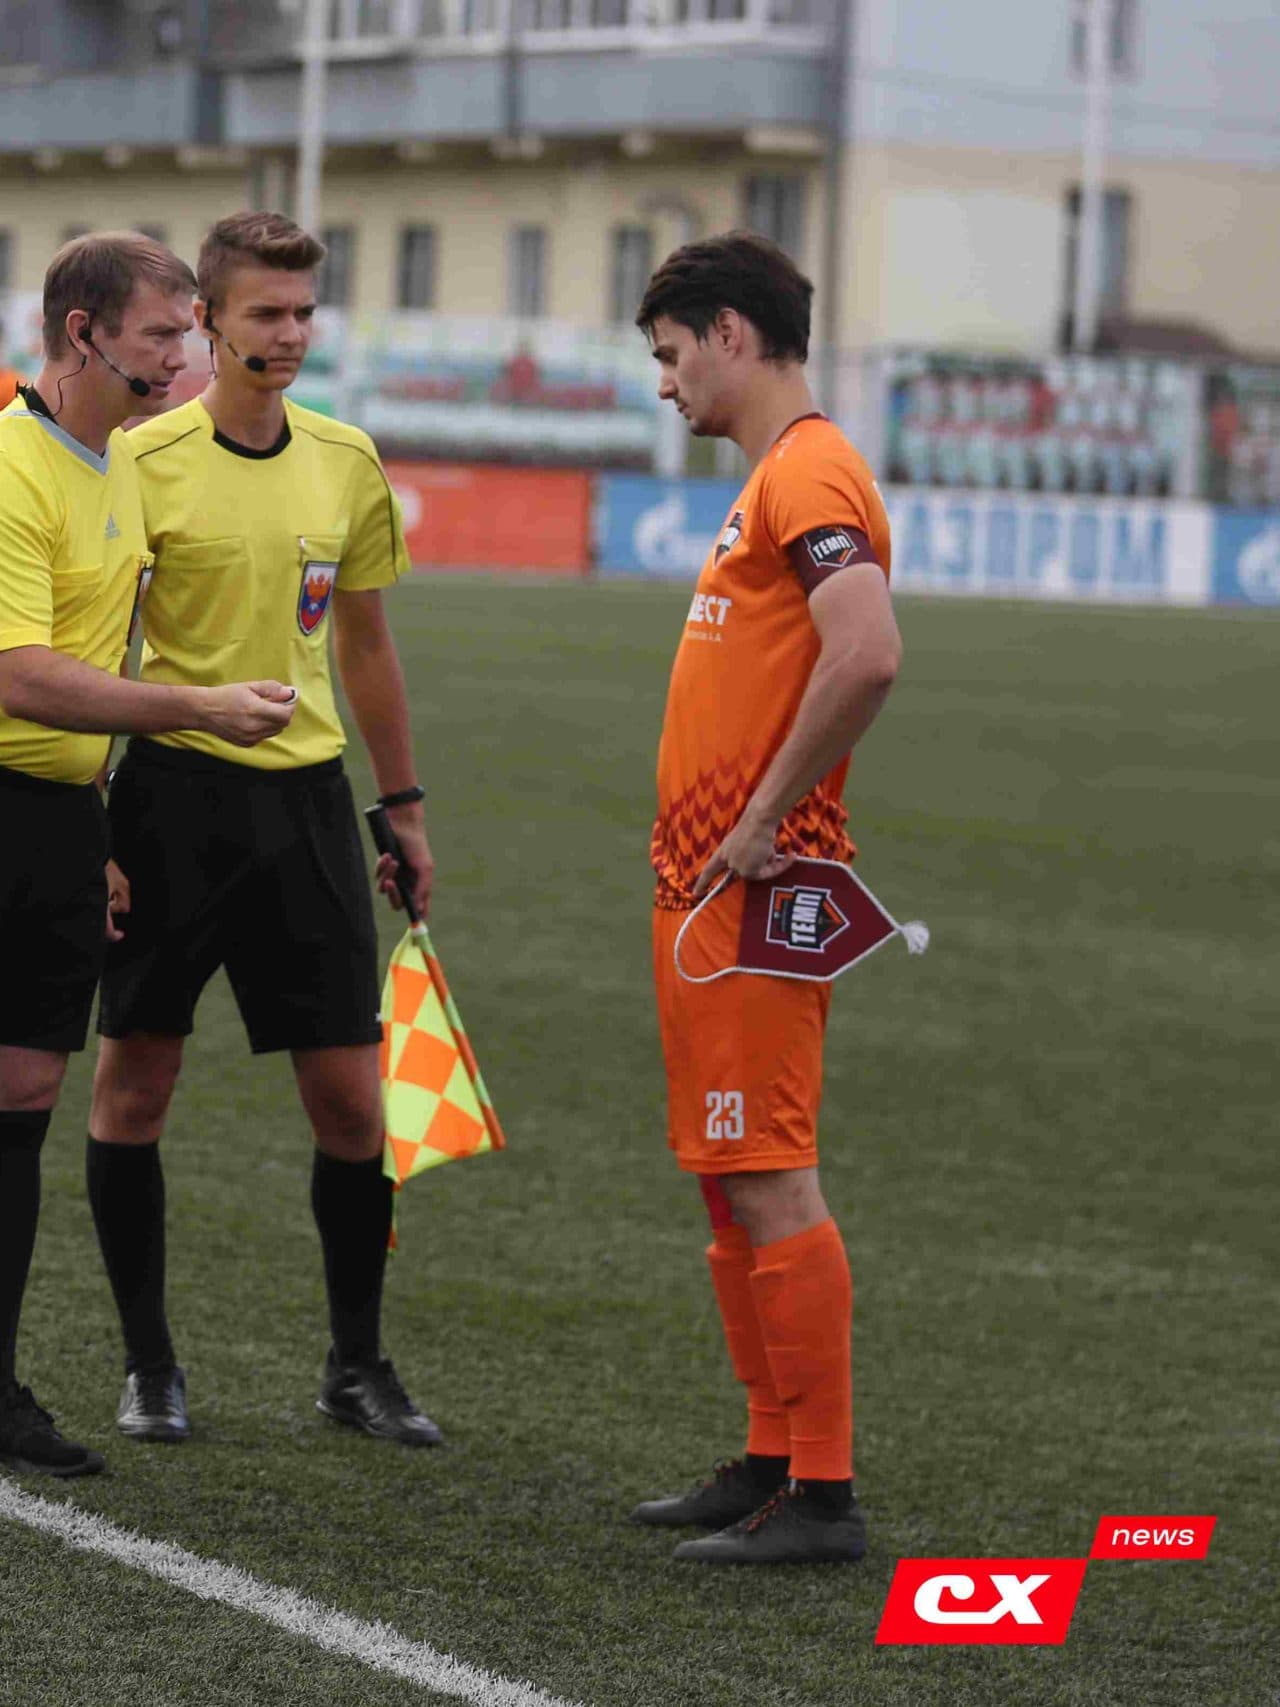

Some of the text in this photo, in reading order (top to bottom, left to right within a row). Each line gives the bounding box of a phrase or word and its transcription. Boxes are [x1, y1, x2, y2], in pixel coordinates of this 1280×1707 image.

[883, 500, 1168, 586] АЗПРОМ
[791, 893, 822, 944] ТЕМП
[706, 1091, 745, 1139] 23
